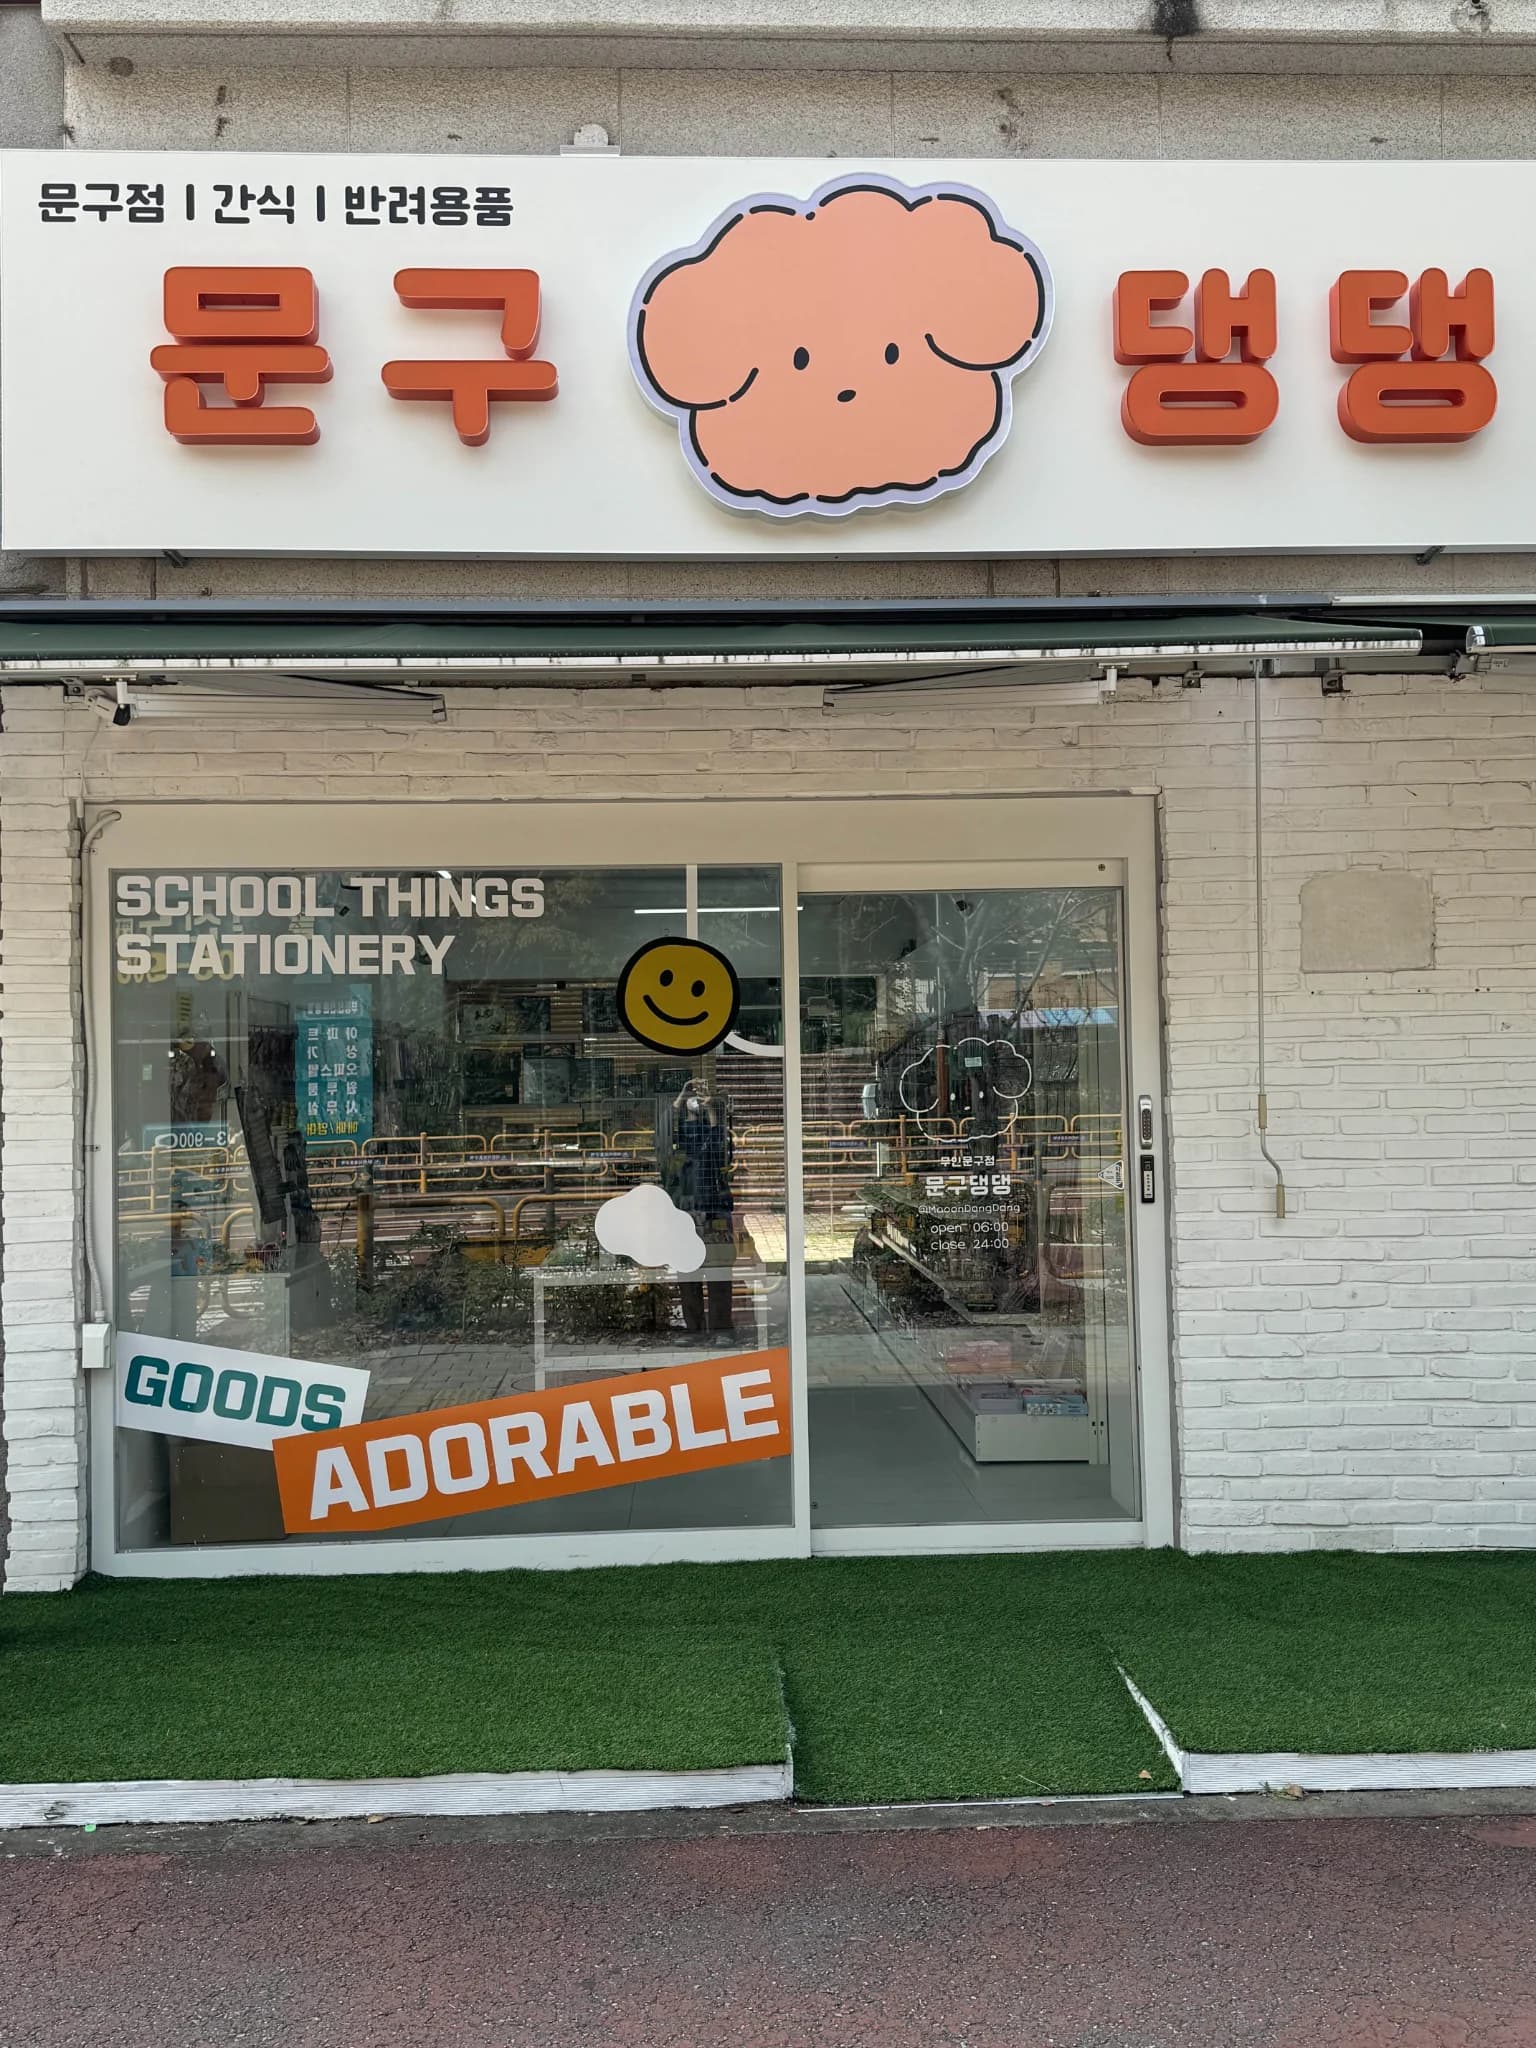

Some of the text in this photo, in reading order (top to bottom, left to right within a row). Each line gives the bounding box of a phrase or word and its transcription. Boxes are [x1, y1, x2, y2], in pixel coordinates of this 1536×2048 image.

[38, 183, 514, 227] 문구점 간식 반려용품
[150, 266, 1498, 447] 문구 댕댕
[116, 875, 545, 919] SCHOOL THINGS
[116, 933, 456, 976] STATIONERY
[940, 1155, 996, 1168] 무인문구점
[924, 1173, 1012, 1196] 문구댕댕
[930, 1221, 1009, 1236] open 06:00
[930, 1237, 1009, 1250] close 24:00
[124, 1354, 347, 1431] GOODS
[309, 1368, 780, 1520] ADORABLE
